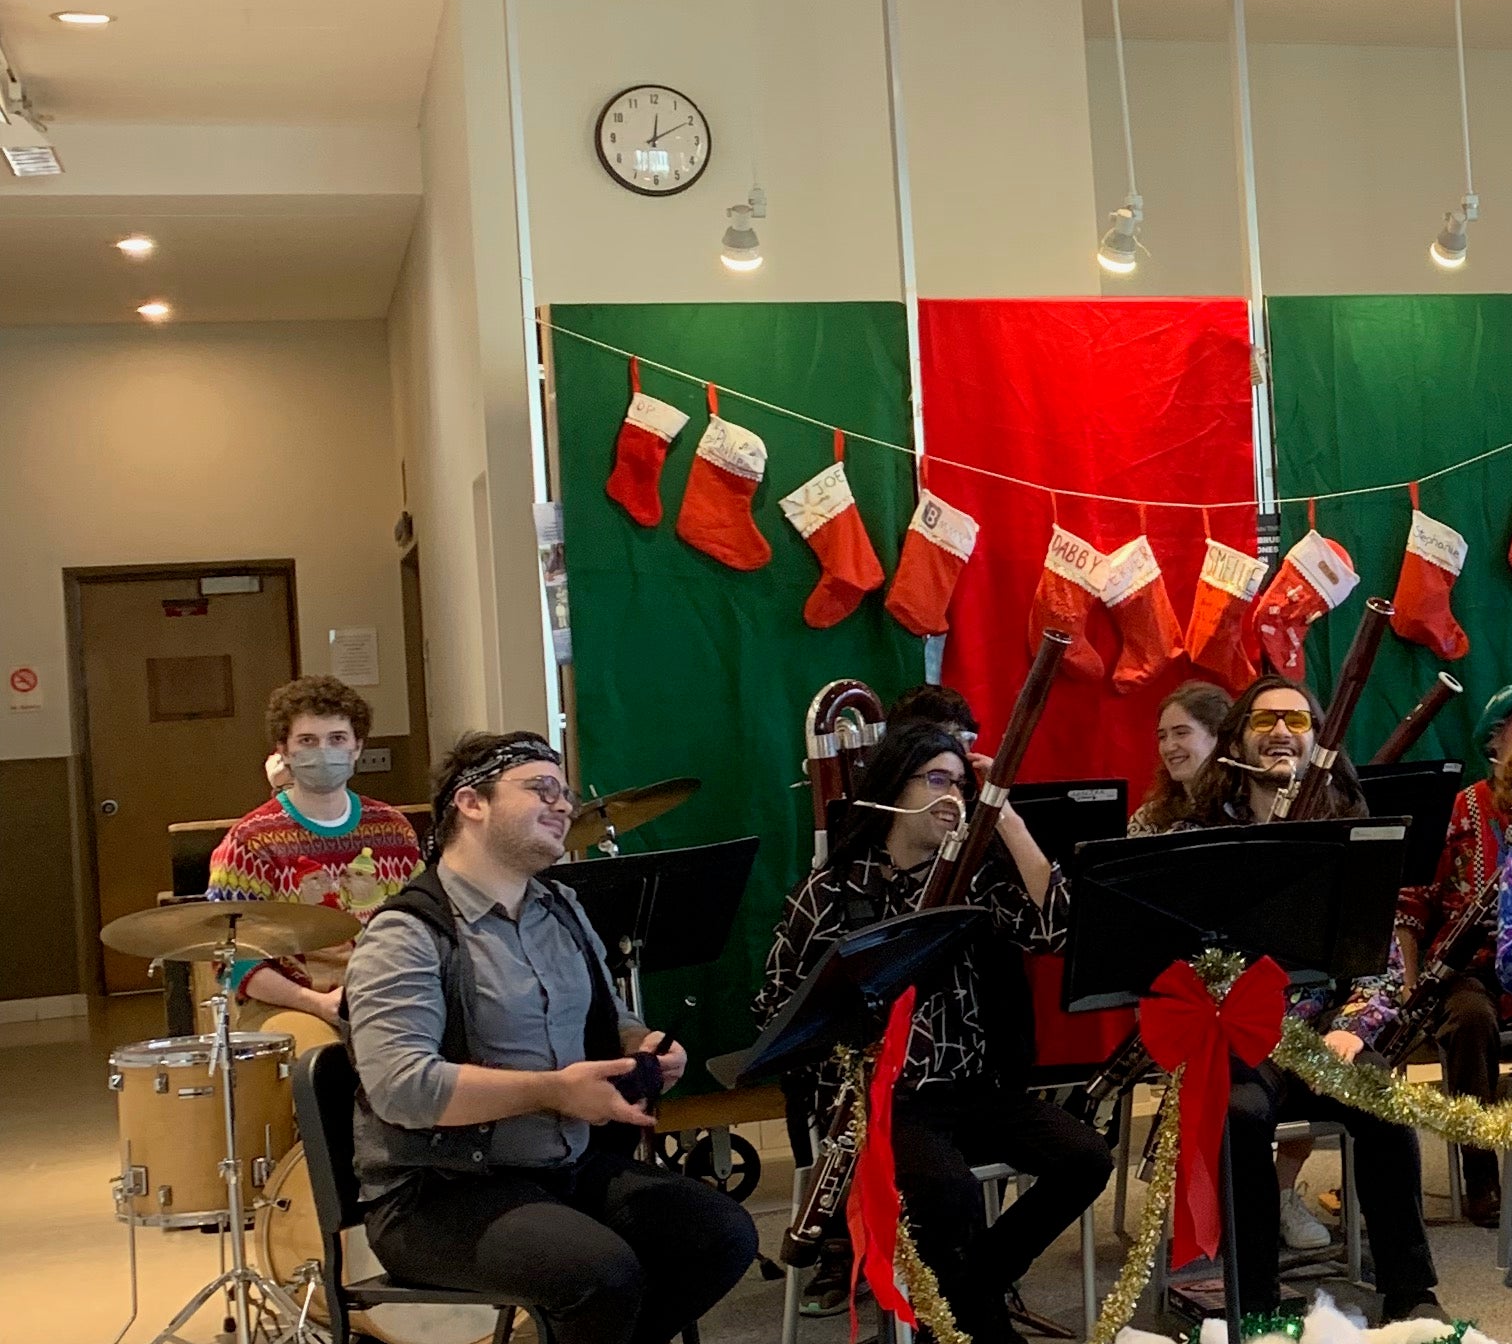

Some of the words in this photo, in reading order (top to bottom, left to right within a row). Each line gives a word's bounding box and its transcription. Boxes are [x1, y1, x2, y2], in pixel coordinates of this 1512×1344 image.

[628, 98, 638, 109] 11
[650, 94, 659, 105] 12
[614, 112, 624, 123] 10
[811, 469, 847, 496] JOE
[1414, 524, 1461, 558] Stephanie
[1051, 534, 1103, 575] DABBY
